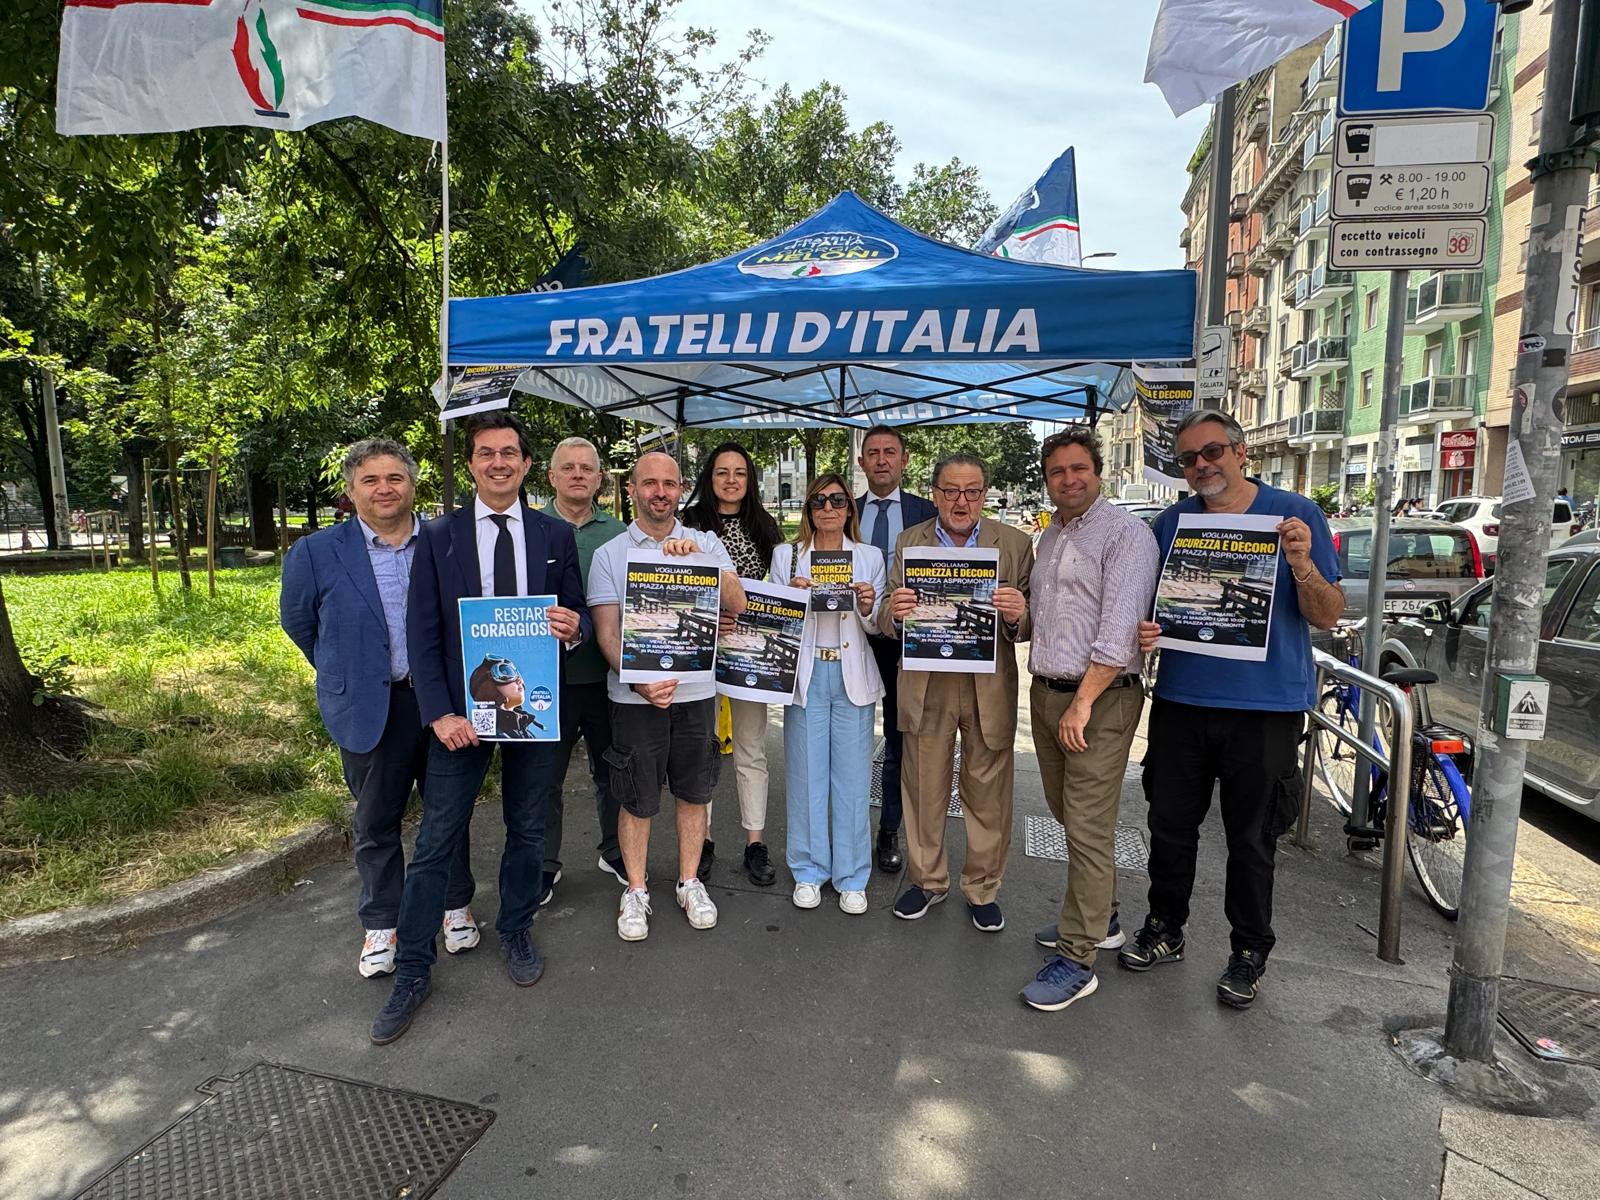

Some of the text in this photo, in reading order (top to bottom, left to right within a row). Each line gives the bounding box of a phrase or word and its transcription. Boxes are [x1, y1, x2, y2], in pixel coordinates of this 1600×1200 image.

[1376, 0, 1466, 92] P
[1398, 173, 1423, 183] 8.00
[1435, 172, 1466, 182] 19.00
[1396, 188, 1449, 202] € 1,20 h
[1374, 204, 1402, 212] codice
[1452, 202, 1474, 210] 3019
[1341, 228, 1426, 241] eccetto veicoli
[756, 250, 878, 264] MELONI
[1340, 246, 1438, 258] con contrassegno
[546, 308, 1040, 356] FRATELLI D'ITALIA
[1159, 390, 1192, 399] DECORO
[1201, 532, 1243, 540] VOGLIAMO
[1174, 538, 1275, 554] SICUREZZA E DECORO
[1209, 551, 1272, 560] ASPROMONTE
[811, 564, 852, 574] SICUREZZA
[906, 568, 995, 577] SICUREZZA E DECORO
[629, 572, 717, 586] SICUREZZA E DECORO
[820, 574, 850, 583] DECORO
[748, 595, 782, 606] VOGLIAMO
[1384, 601, 1396, 610] EF
[758, 612, 800, 622] ASPROMONTE
[772, 607, 804, 618] DECORO
[471, 622, 552, 638] CORAGGIOSI
